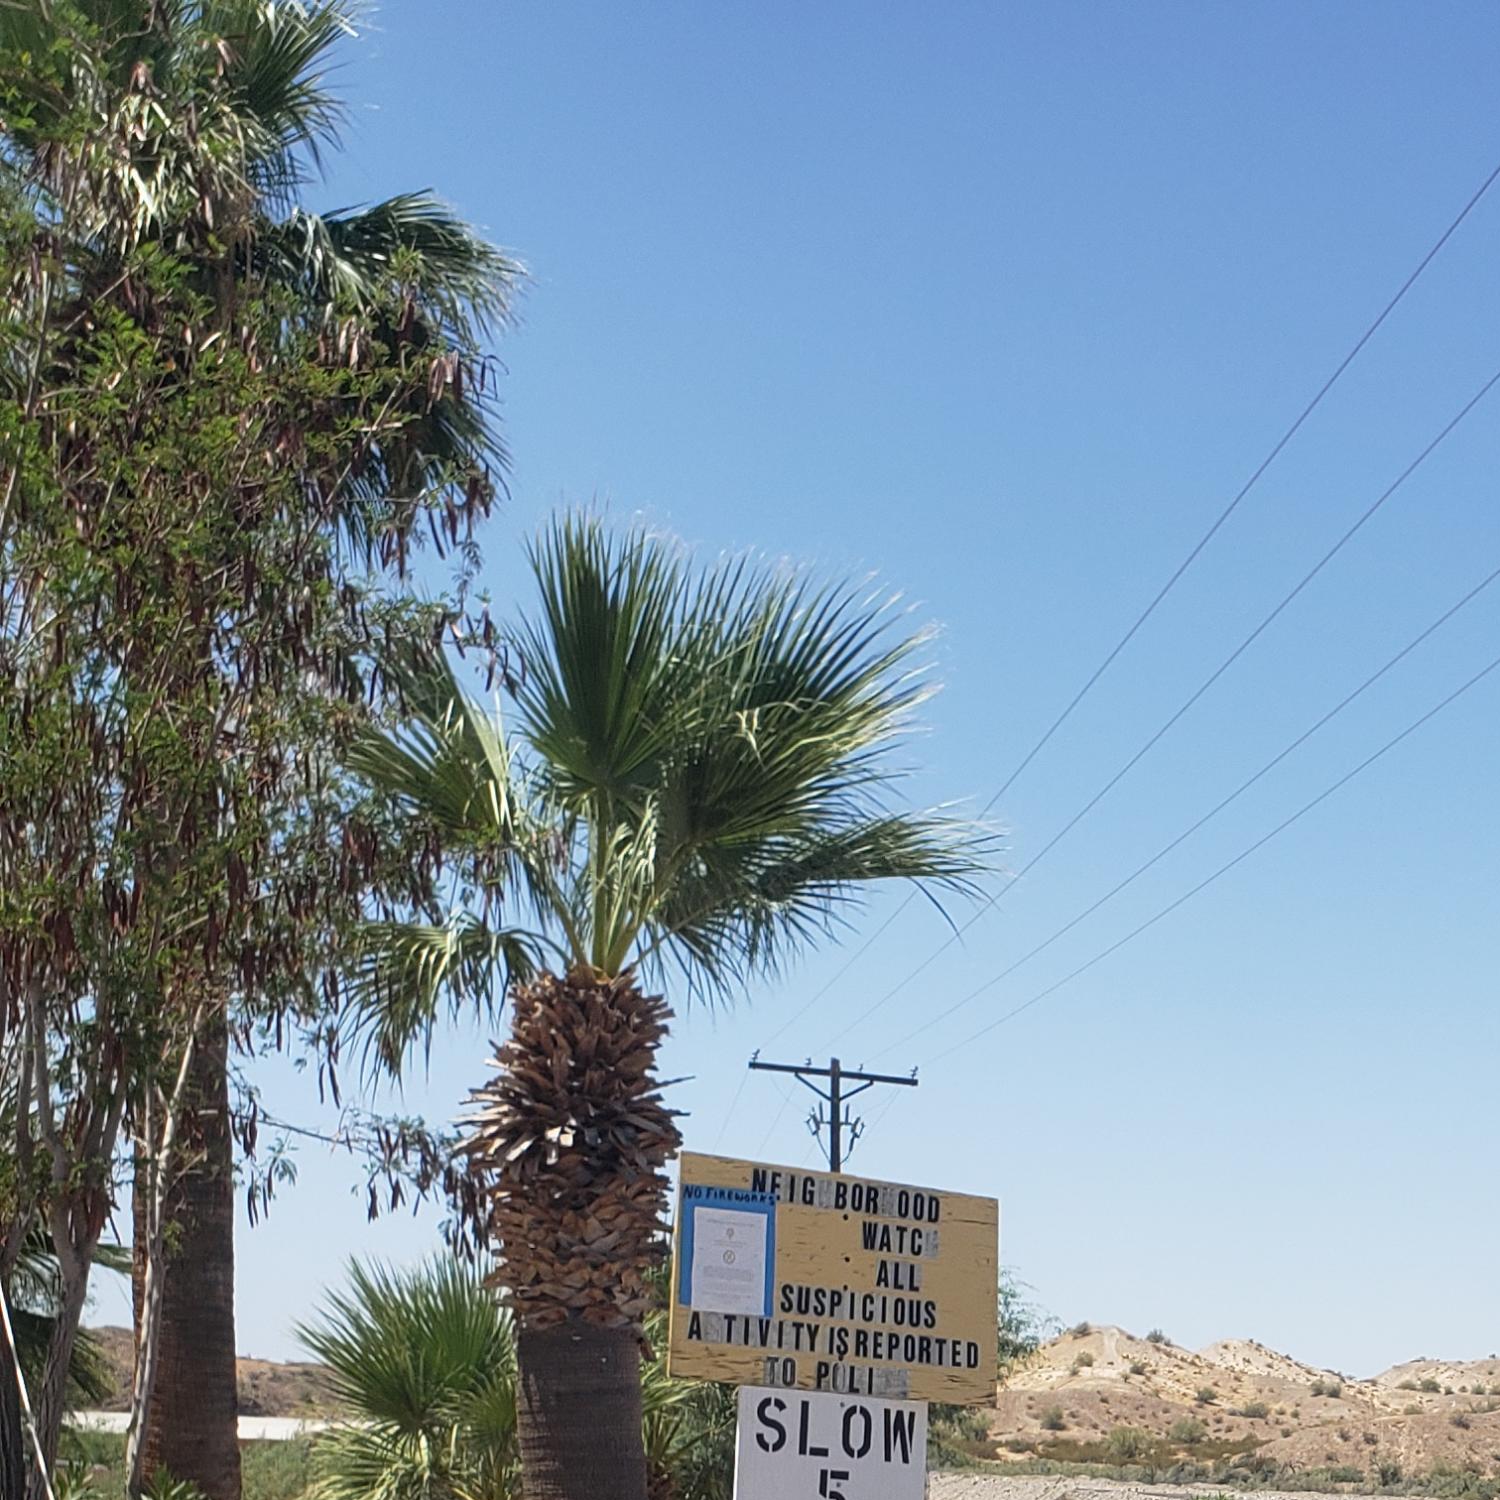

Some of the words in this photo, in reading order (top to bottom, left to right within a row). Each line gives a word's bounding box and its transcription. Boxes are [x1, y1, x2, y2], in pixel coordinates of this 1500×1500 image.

[683, 1185, 701, 1199] NO
[752, 1168, 940, 1223] NEIGBOROOD
[862, 1220, 939, 1257] WATC
[876, 1259, 920, 1292] ALL
[780, 1283, 936, 1328] SUSPICIOUS
[688, 1310, 819, 1351] ATIVITY
[855, 1328, 979, 1369] REPORTED
[766, 1356, 796, 1387] TO
[816, 1361, 908, 1396] POLI
[756, 1396, 916, 1464] SLOW
